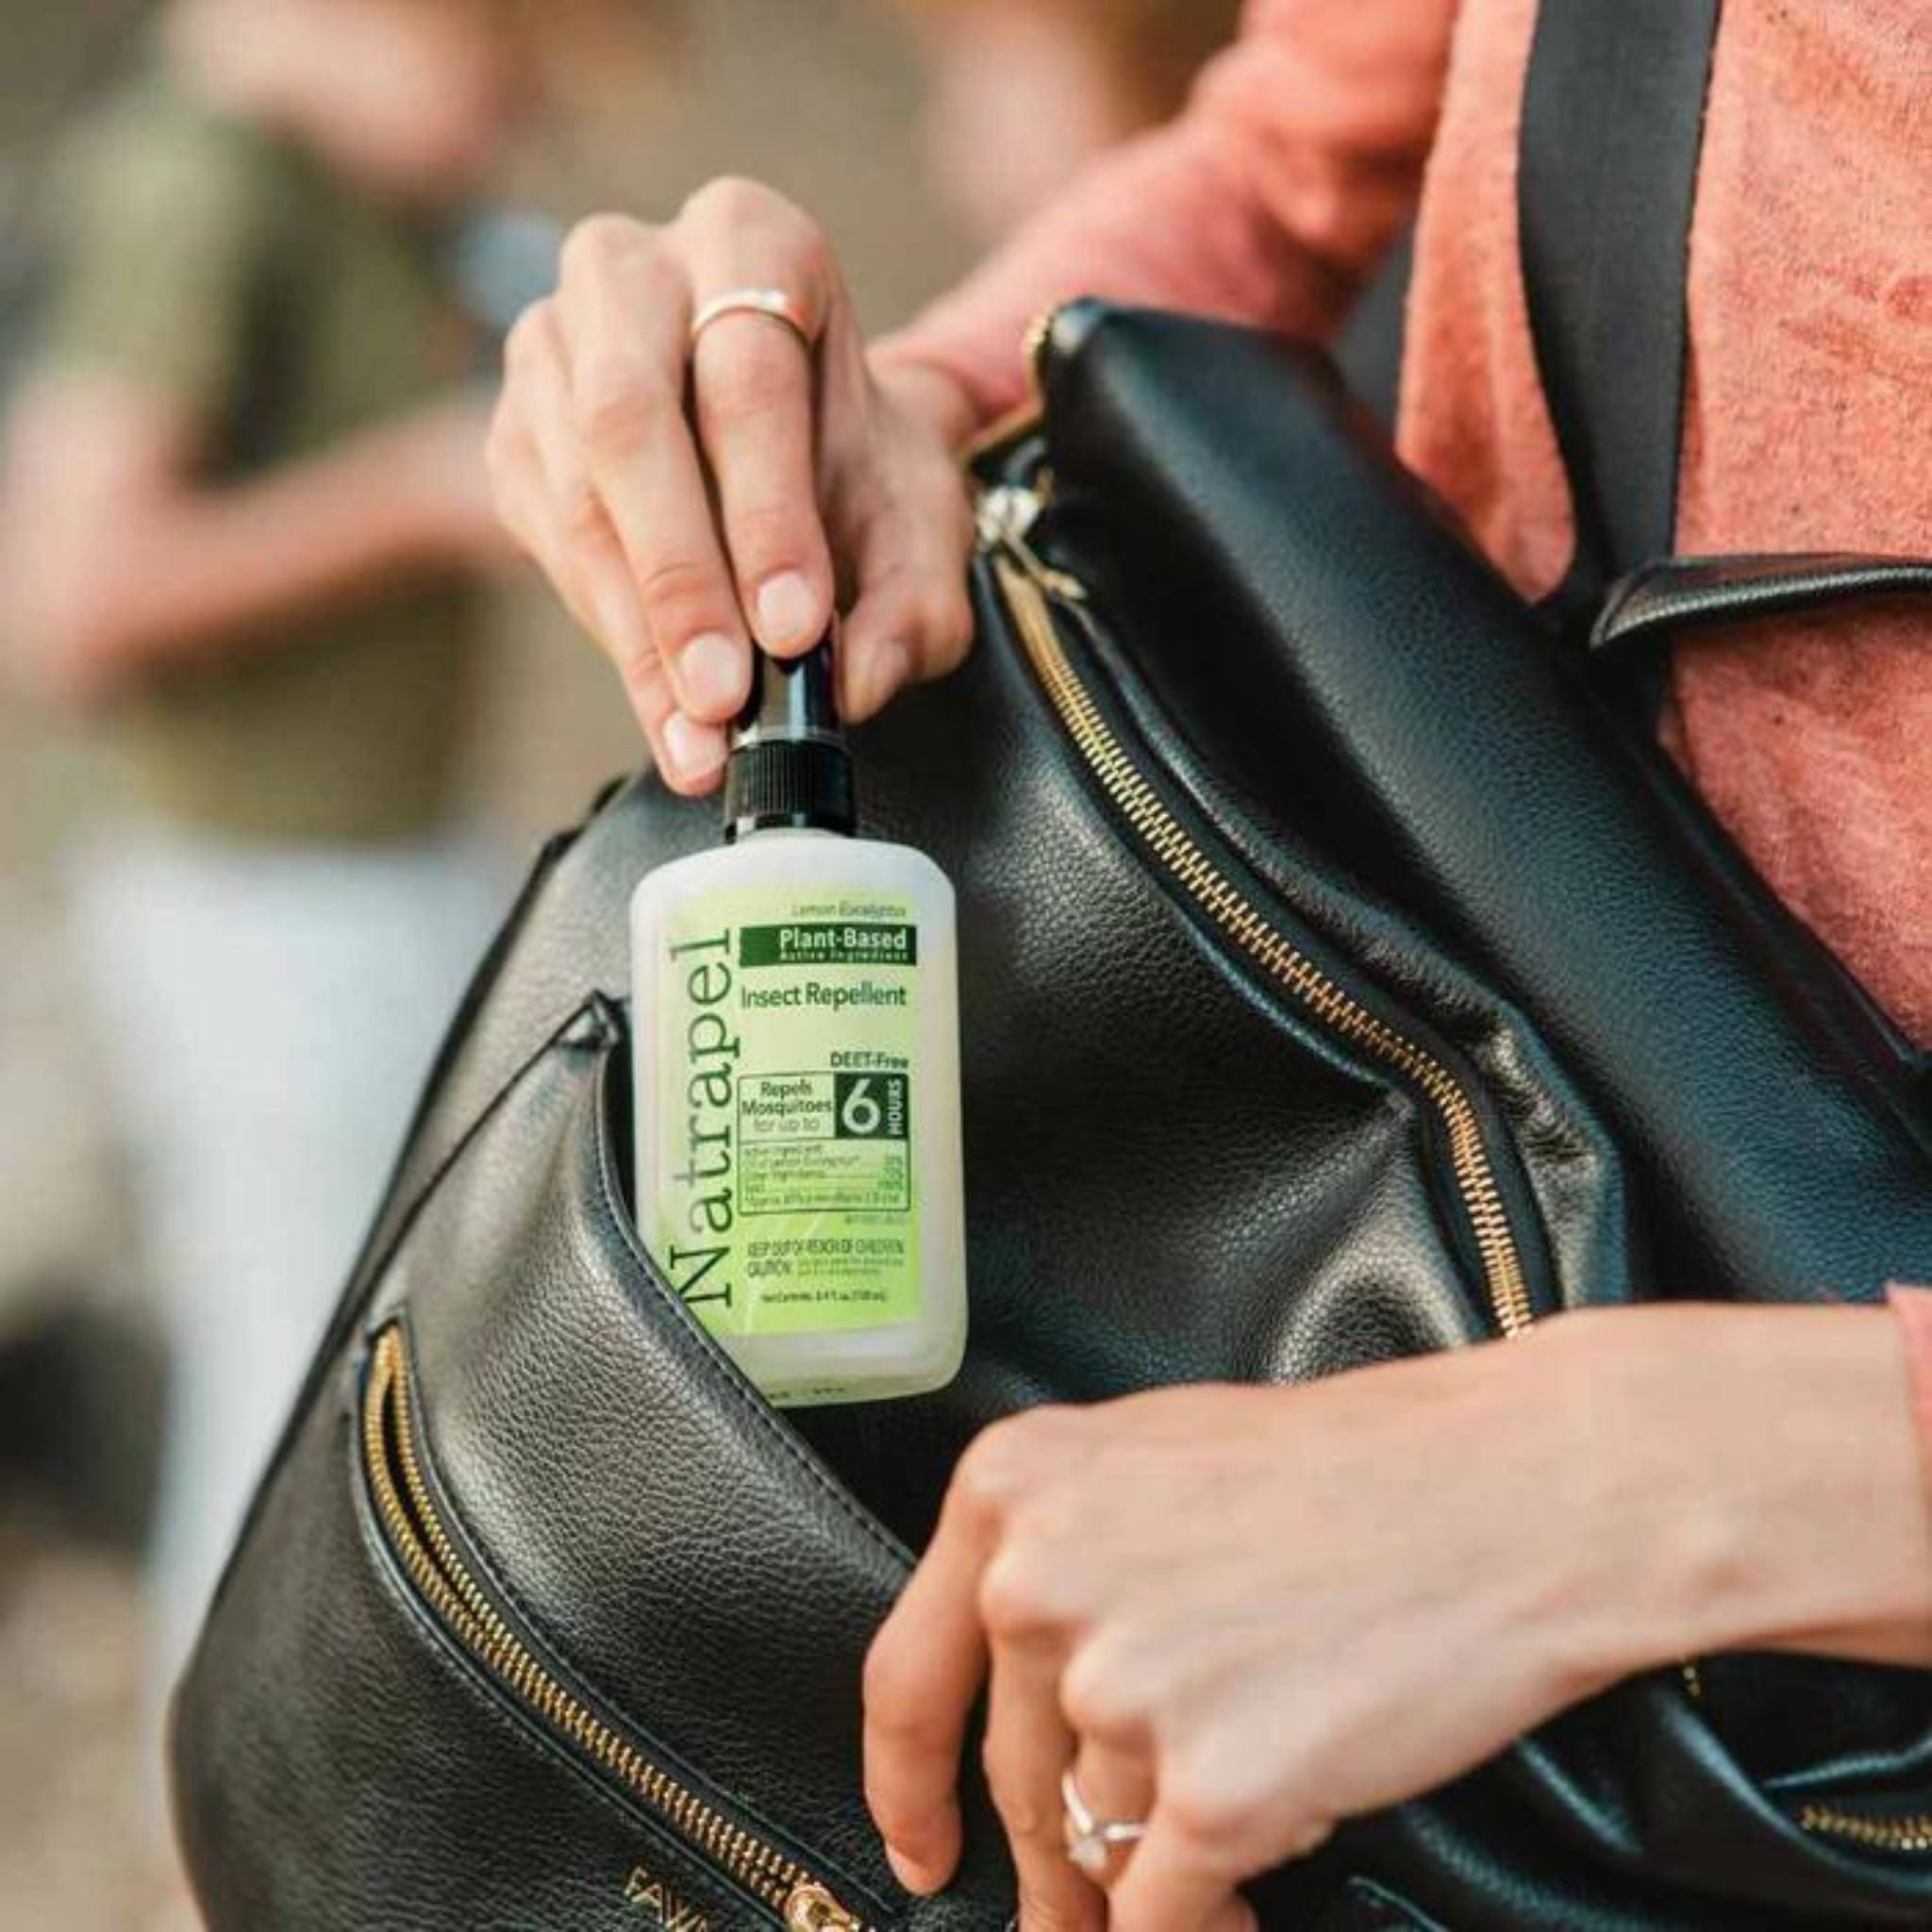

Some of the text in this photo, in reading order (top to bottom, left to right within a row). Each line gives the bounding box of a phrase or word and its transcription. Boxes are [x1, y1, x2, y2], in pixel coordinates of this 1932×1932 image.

[780, 927, 907, 950] Plant-Based
[741, 982, 907, 1010] Insect Repellent
[830, 1052, 908, 1069] DEET-Free
[760, 1081, 812, 1098] Repels
[670, 928, 740, 1308] Natrapel
[741, 1097, 832, 1117] Mosquitoes
[842, 1077, 881, 1134] 6
[888, 1080, 903, 1135] HOURS
